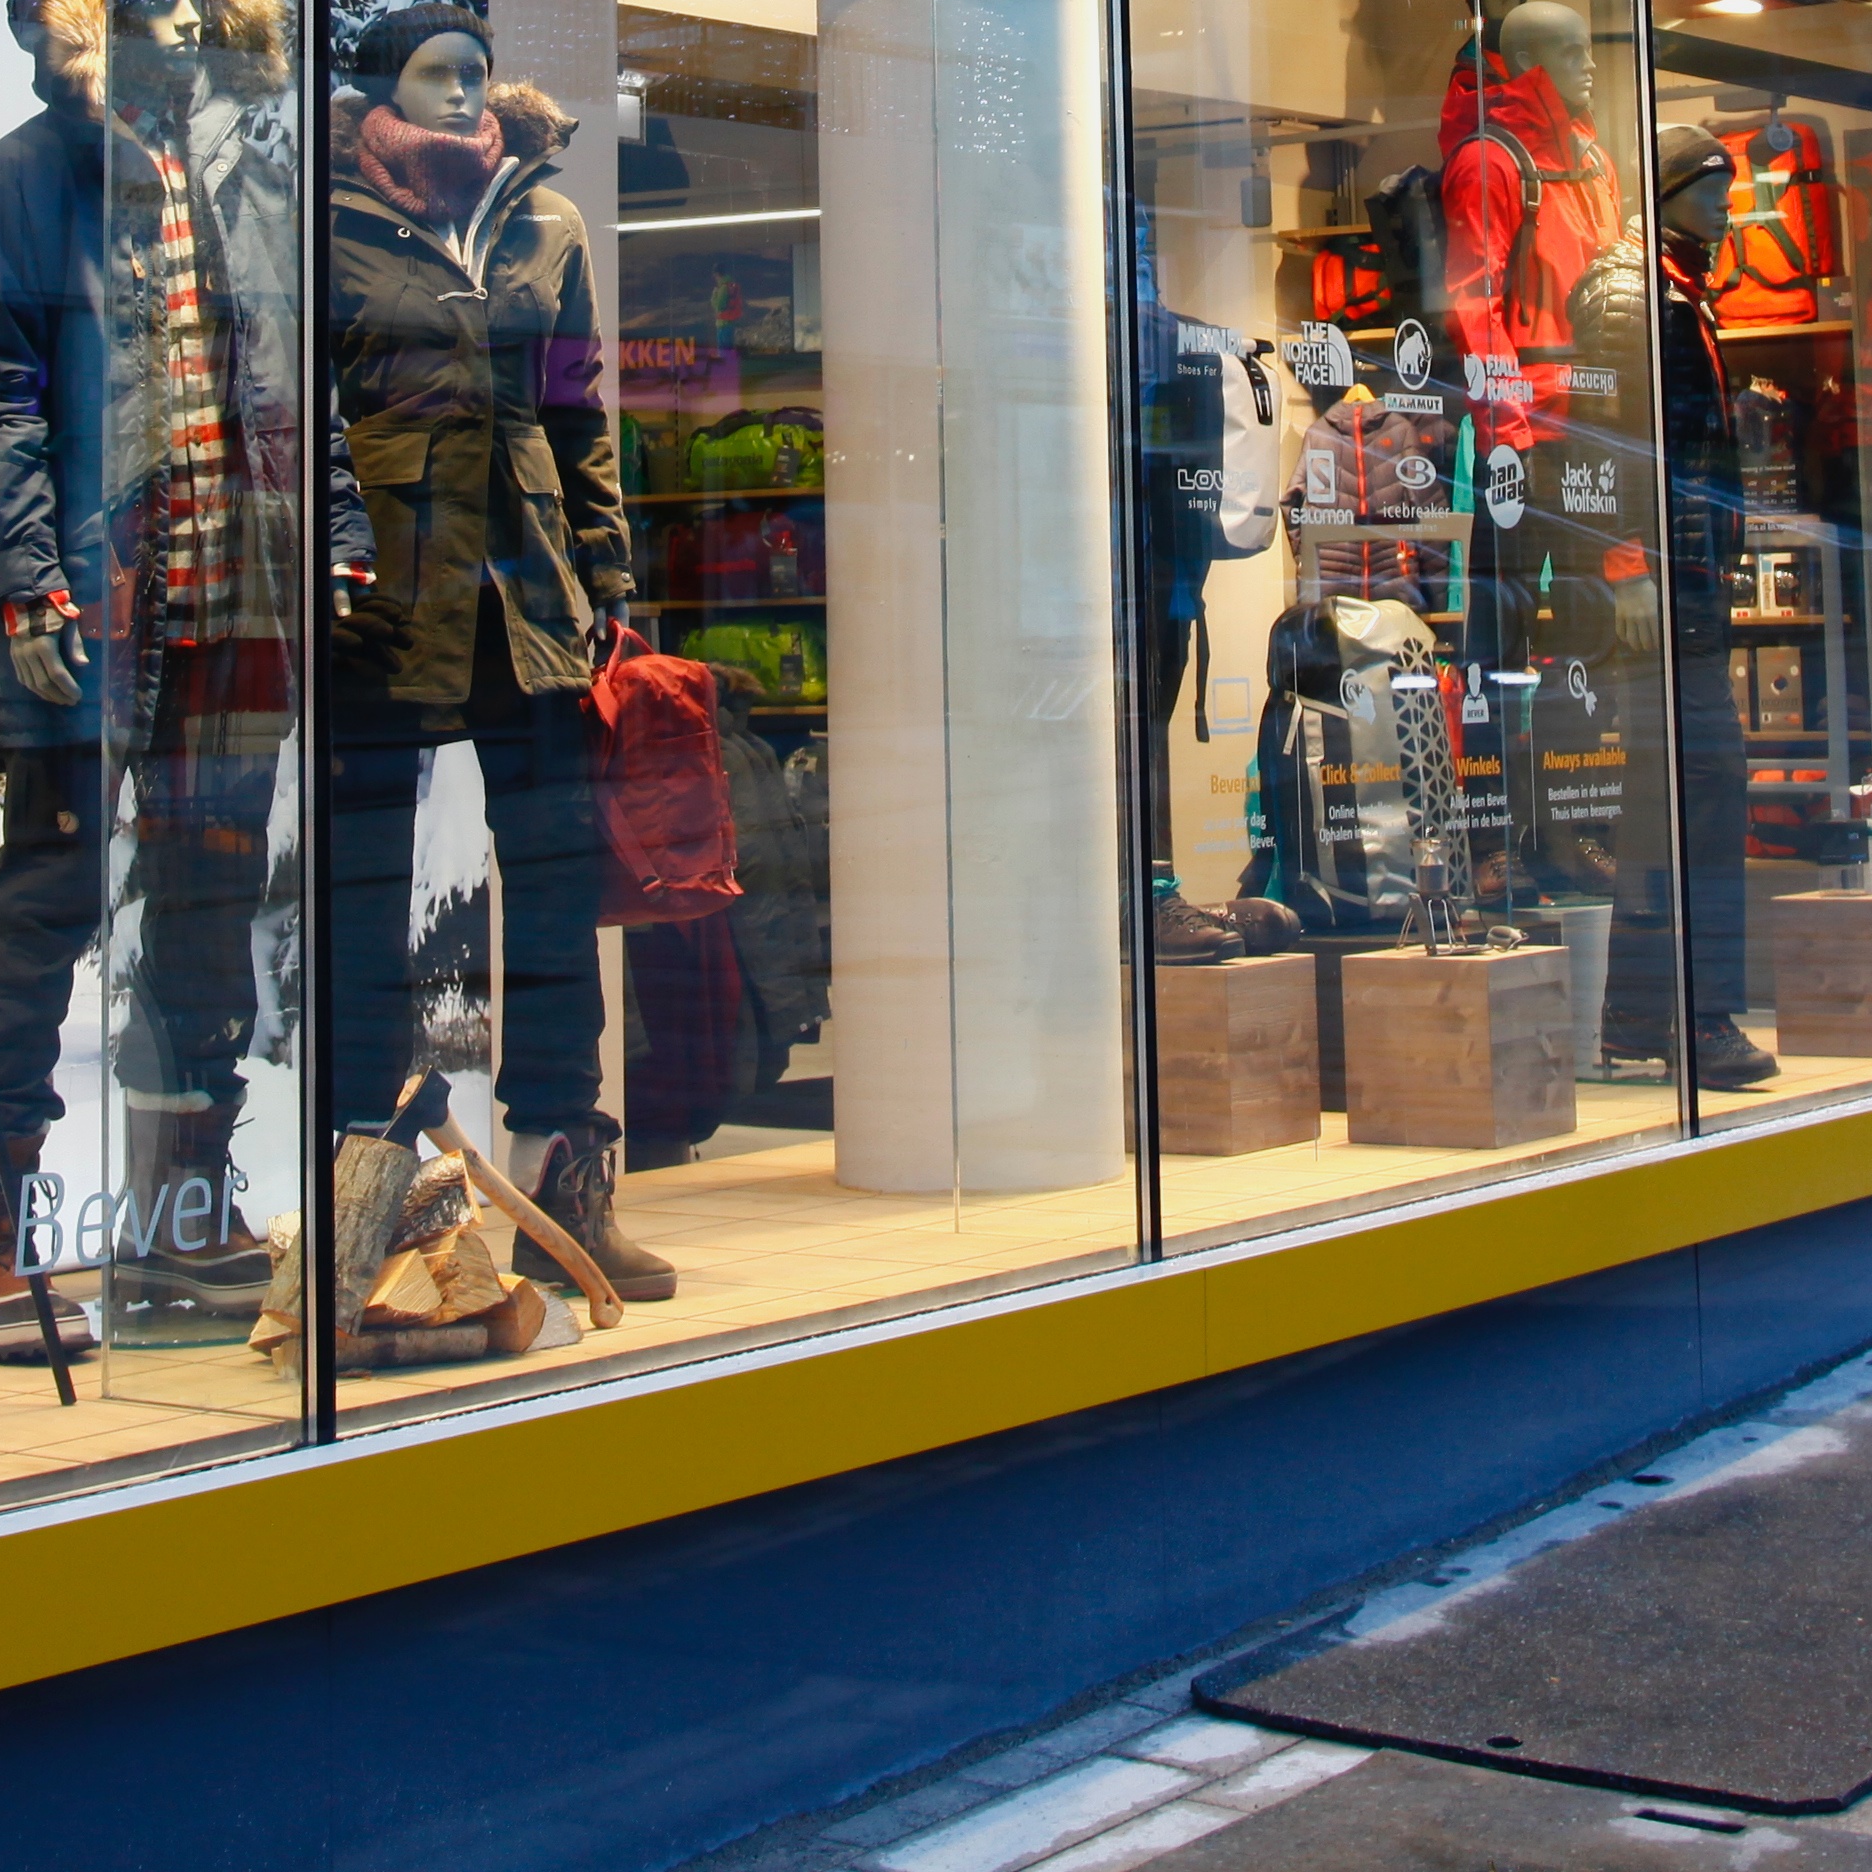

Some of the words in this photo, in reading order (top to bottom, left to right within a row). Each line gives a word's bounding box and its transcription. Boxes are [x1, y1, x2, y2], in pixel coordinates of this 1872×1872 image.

[1301, 321, 1328, 342] THE
[1282, 342, 1328, 364] NORTH
[1295, 363, 1328, 386] FACE
[1386, 396, 1441, 412] MAMMUT
[1561, 461, 1592, 488] Jack
[1187, 496, 1218, 513] simply
[1383, 501, 1451, 519] icebreaker
[1562, 487, 1617, 514] Wolfskin
[1456, 754, 1502, 777] Winkels
[1543, 749, 1581, 773] Always
[1582, 746, 1627, 767] available
[1320, 763, 1348, 785] Click
[1363, 761, 1402, 784] Collect
[1472, 797, 1485, 808] een
[1486, 792, 1508, 807] Bever
[1548, 784, 1580, 802] Bestellen
[1580, 783, 1588, 799] in
[1589, 783, 1598, 798] de
[1599, 781, 1623, 796] winkel
[1250, 811, 1267, 831] dag
[1329, 804, 1356, 821] Online
[1471, 813, 1480, 828] in
[1480, 812, 1490, 827] de
[1551, 805, 1571, 821] Thuis
[1571, 804, 1589, 819] laten
[1250, 834, 1277, 850] Bever.
[1319, 825, 1353, 846] Ophalen
[14, 1165, 245, 1277] Bever
